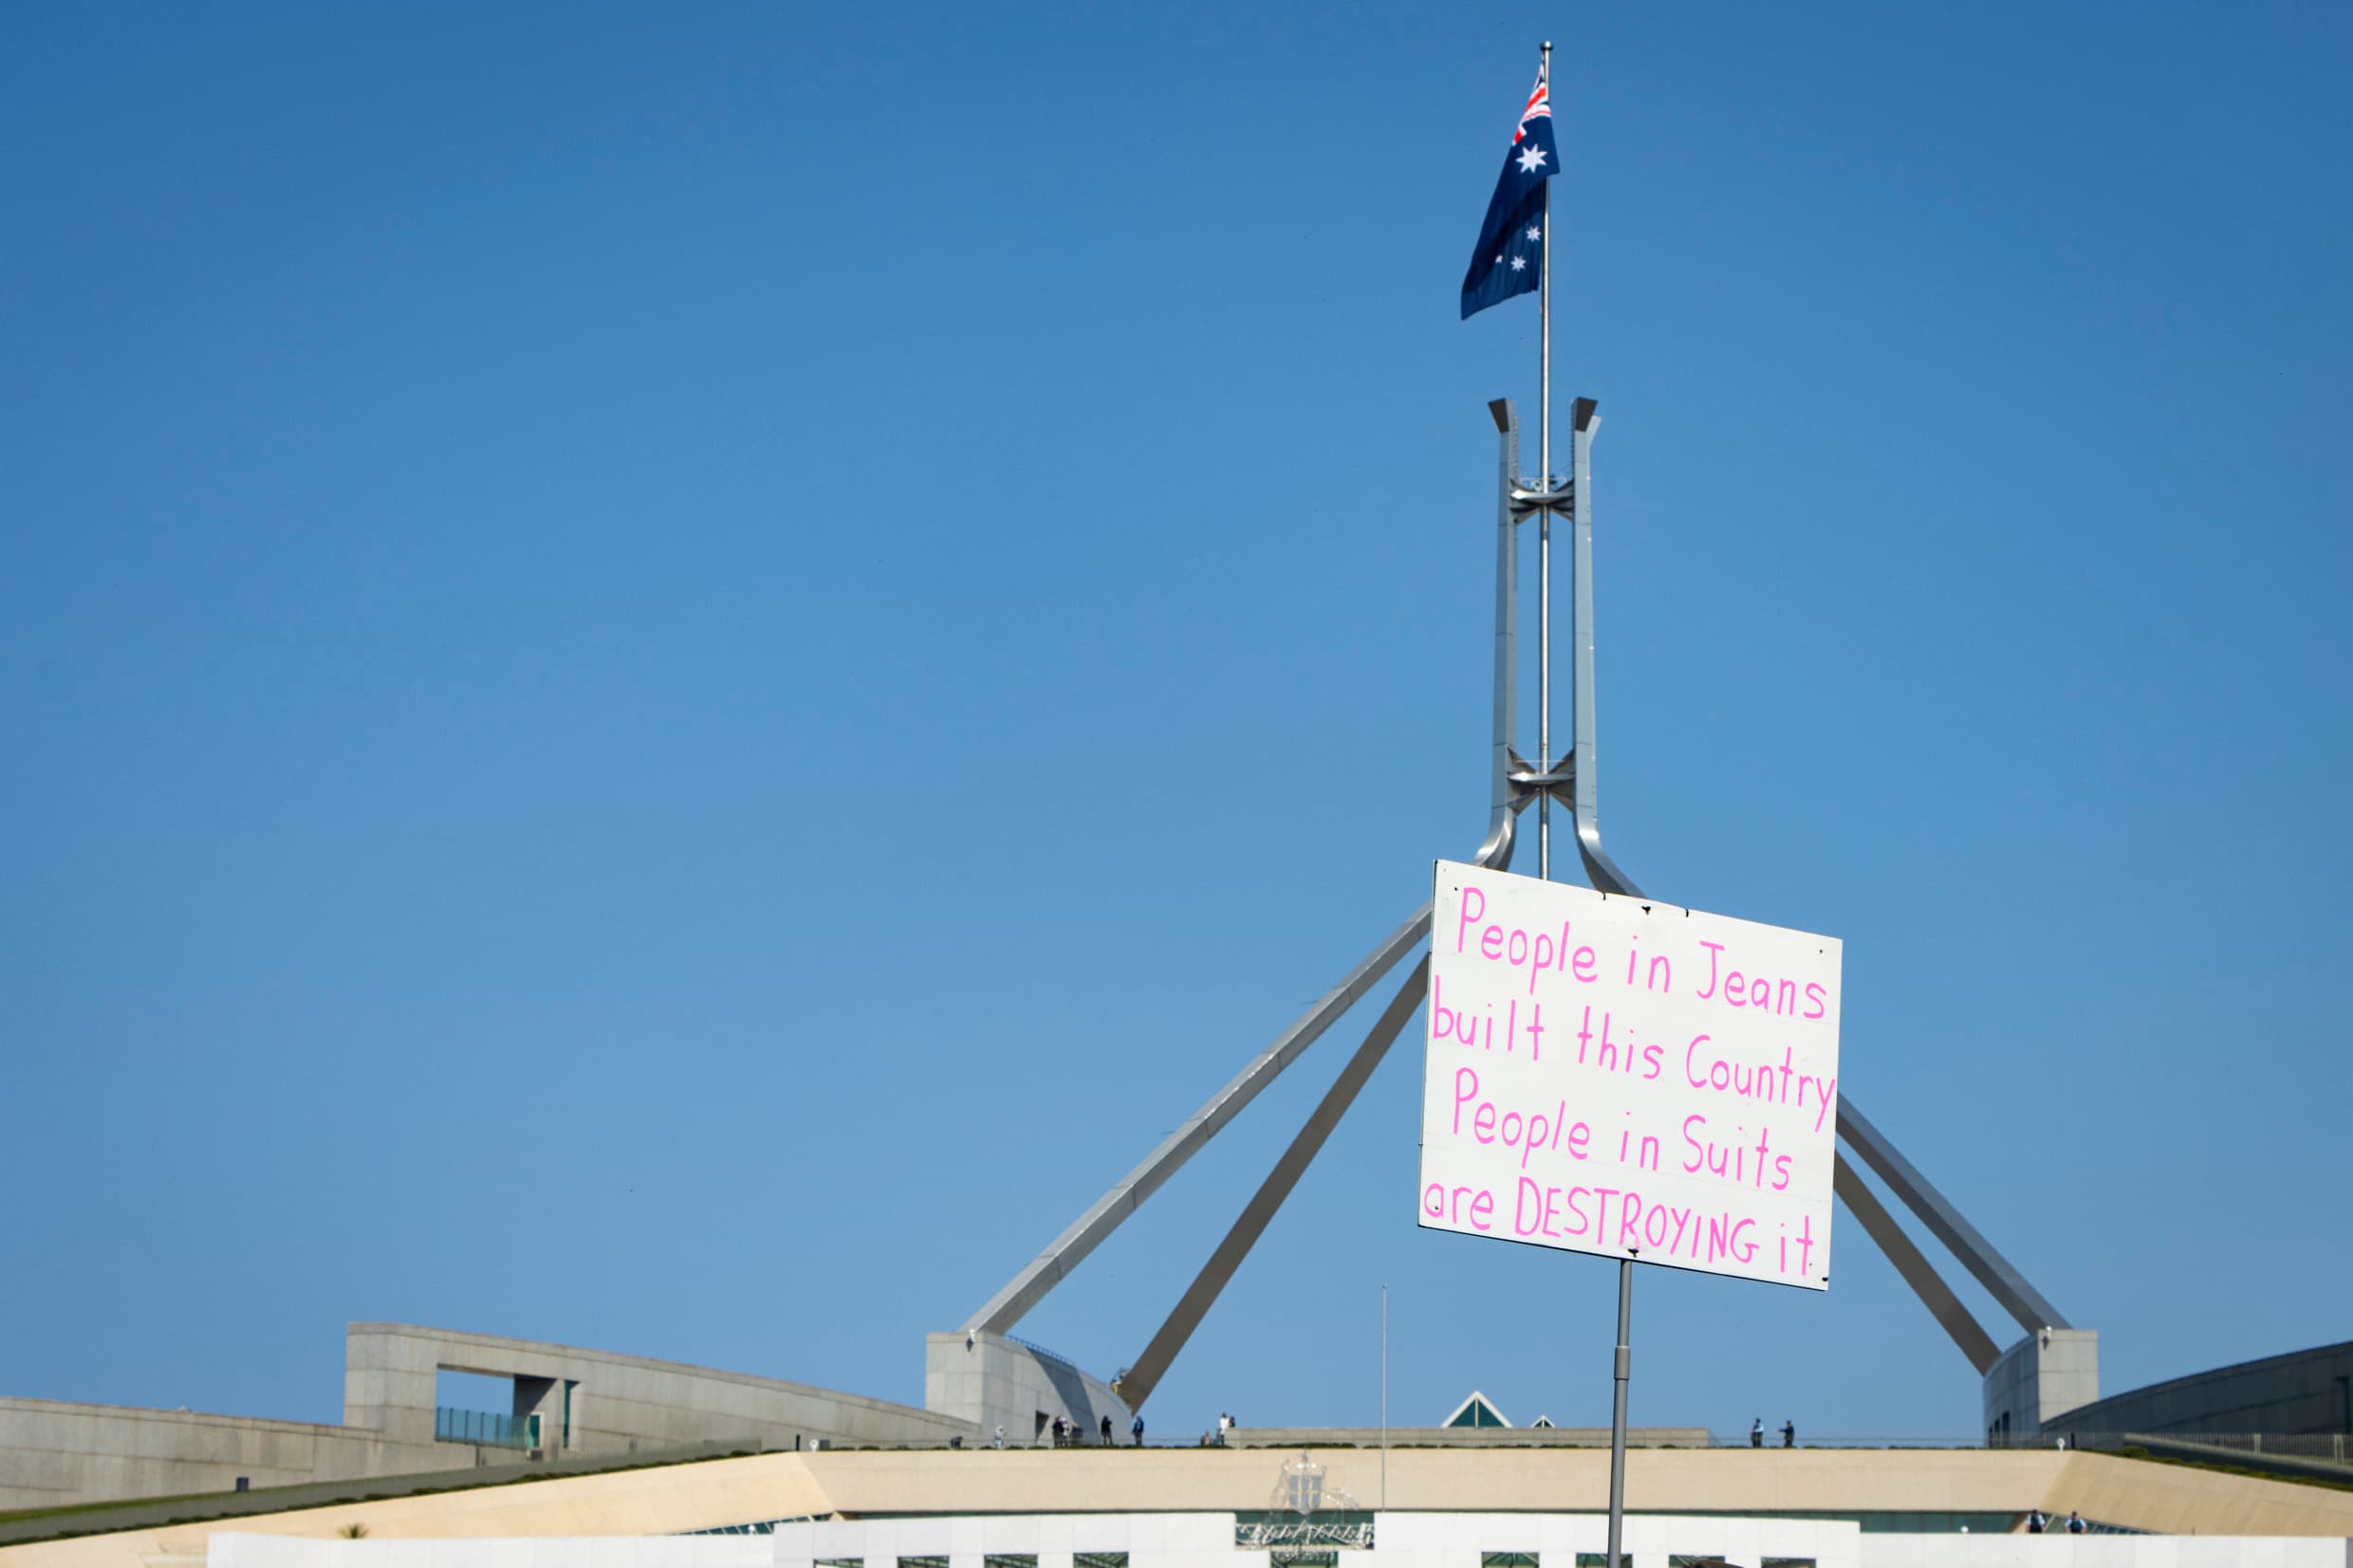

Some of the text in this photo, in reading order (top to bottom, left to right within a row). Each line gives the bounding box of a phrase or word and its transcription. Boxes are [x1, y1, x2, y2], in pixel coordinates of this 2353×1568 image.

[1457, 886, 1827, 1020] People in Jeans
[1432, 974, 1837, 1133] built this Country
[1453, 1066, 1793, 1191] People in Suits
[1423, 1175, 1815, 1276] are DESTROYING it
